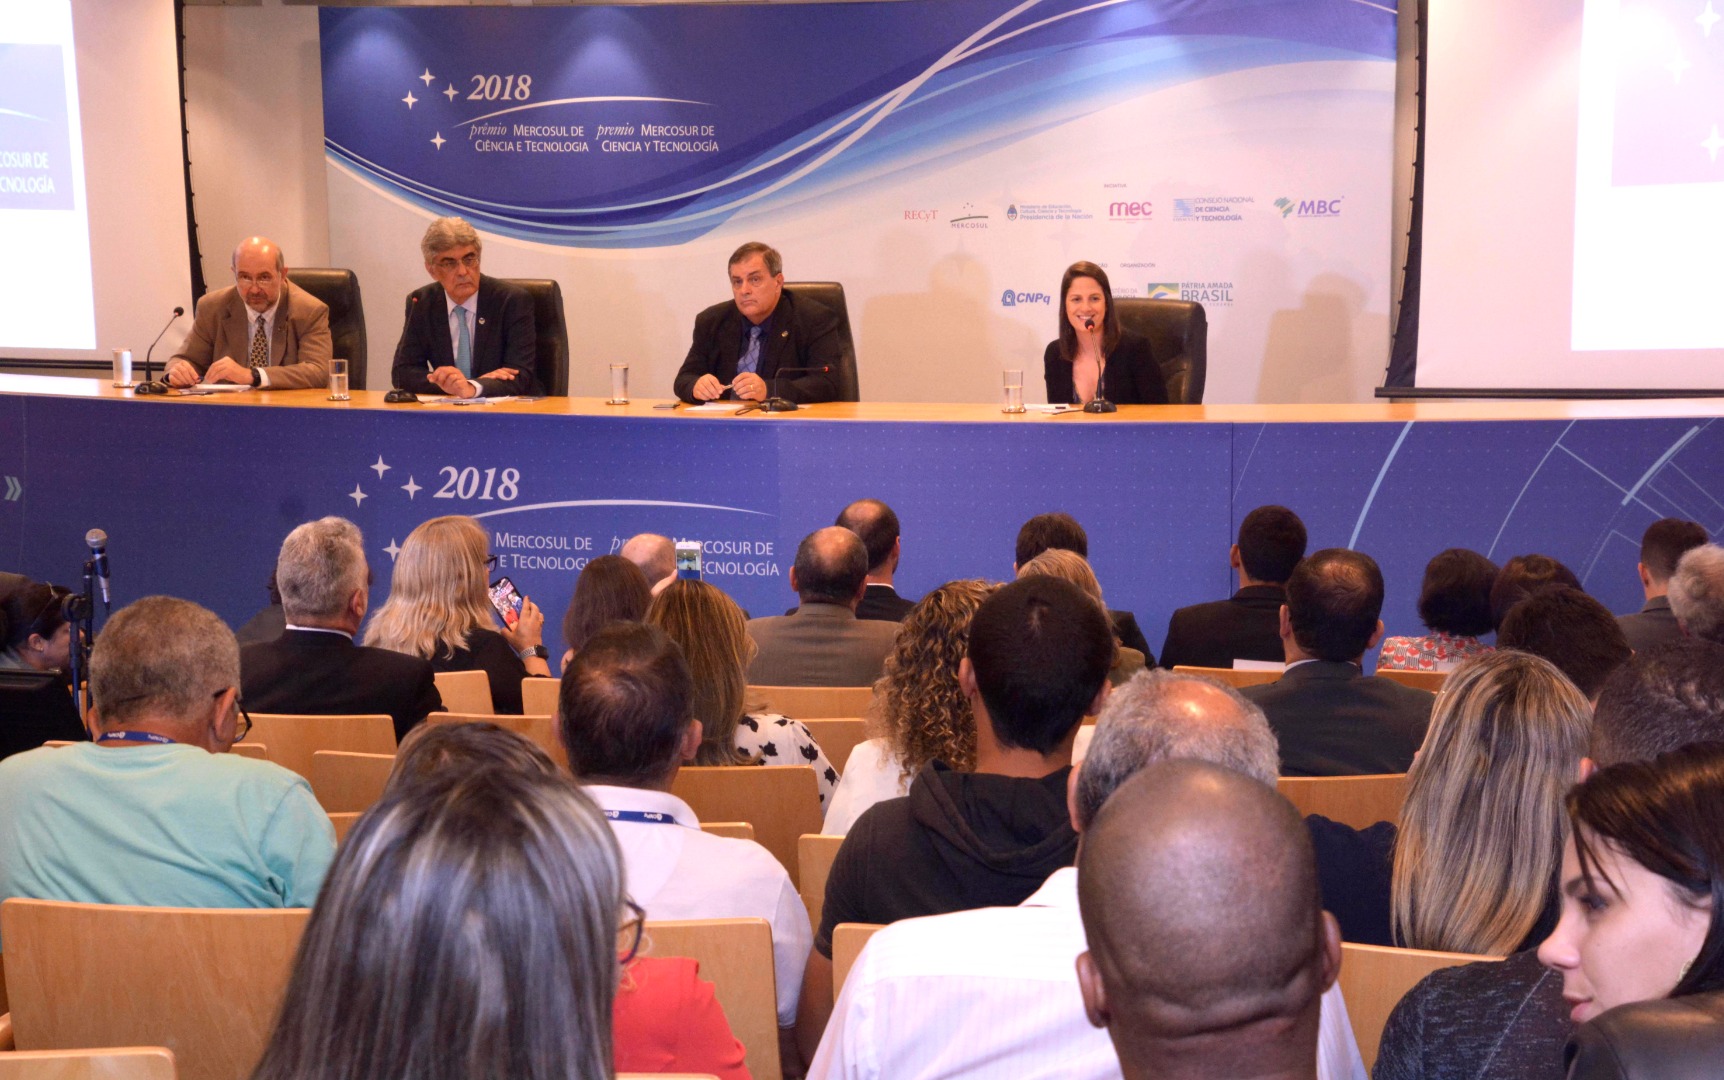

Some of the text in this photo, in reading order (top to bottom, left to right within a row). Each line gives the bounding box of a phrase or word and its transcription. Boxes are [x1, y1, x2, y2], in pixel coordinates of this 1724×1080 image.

[467, 74, 532, 101] 2018
[469, 122, 584, 140] prêmio MERCOSUL DE
[595, 122, 715, 140] premio MERCOSUR DE
[475, 140, 589, 152] CIÊNCIA E TECNOLOGIA
[601, 139, 719, 152] CIENCIA Y TECNOLOGÍA
[33, 152, 50, 169] DE
[1224, 196, 1255, 204] NACIONAL
[1297, 199, 1341, 215] MBC
[904, 209, 938, 222] RECyT
[1109, 201, 1153, 217] mec
[1020, 213, 1055, 221] Presidencia
[1201, 213, 1243, 222] TECNOLOGÍA
[1181, 281, 1205, 289] PÁTRIA
[1016, 292, 1051, 305] CNPq
[1181, 290, 1233, 302] BRASIL
[433, 466, 521, 501] 2018
[495, 532, 571, 550] MERCOSUL
[574, 537, 593, 551] DE
[755, 542, 774, 556] DE
[499, 554, 507, 568] E
